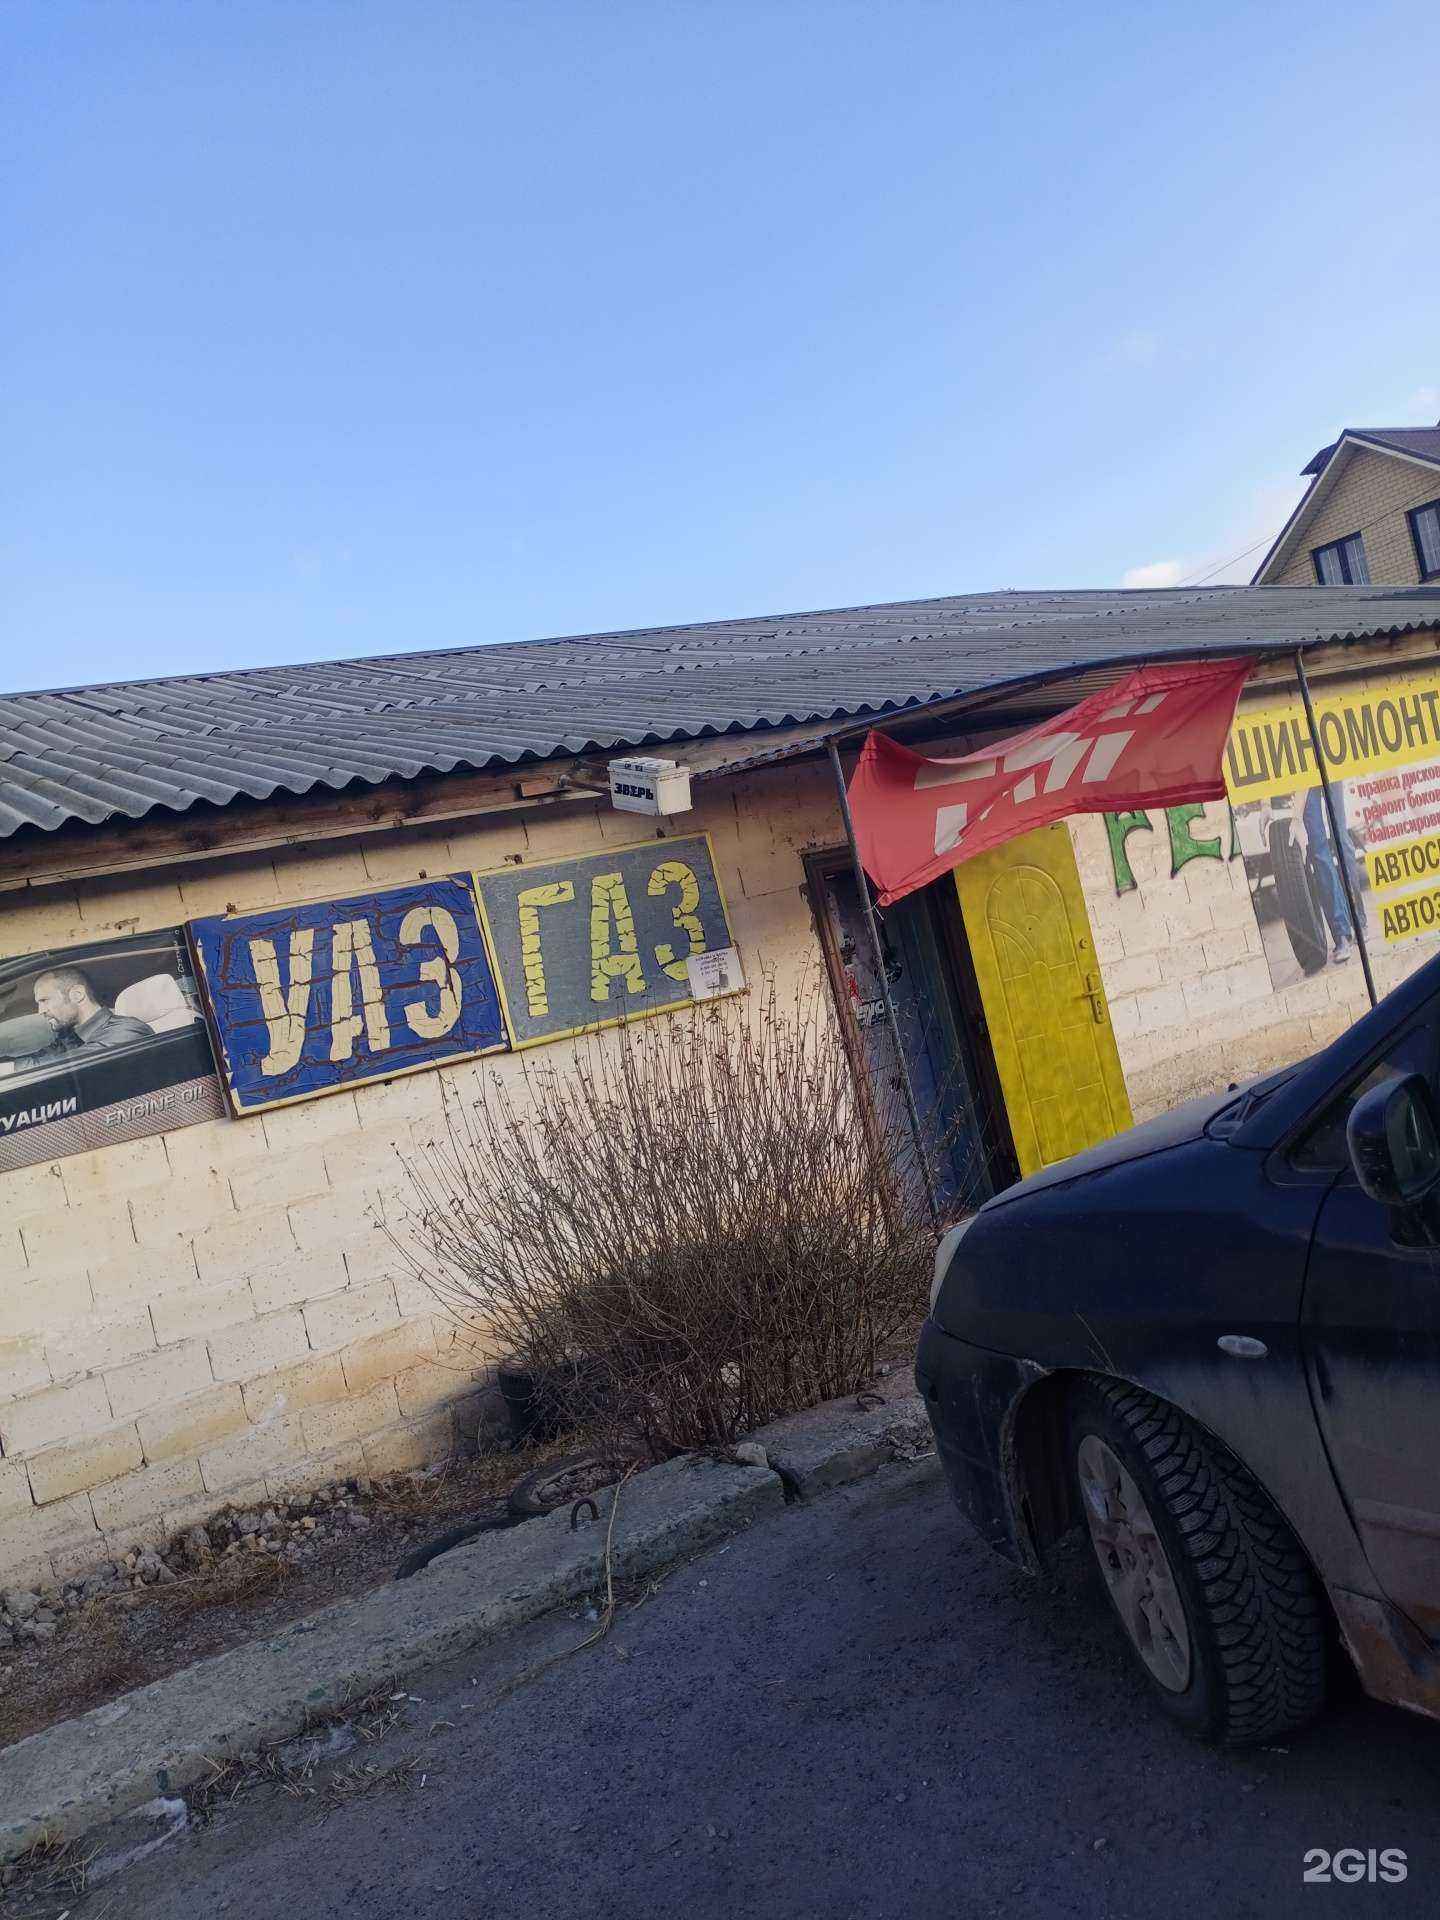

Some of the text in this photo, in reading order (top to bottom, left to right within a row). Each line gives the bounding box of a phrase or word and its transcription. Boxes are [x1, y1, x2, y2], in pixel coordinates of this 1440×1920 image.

[614, 783, 654, 800] ЗВЕРЬ
[1357, 776, 1400, 799] правка
[1363, 798, 1407, 825] ремонт
[1374, 838, 1440, 886] АВТОС
[517, 860, 706, 1017] ГАЗ
[248, 906, 462, 1076] УАЗ
[105, 1086, 209, 1128] ENGINE OIL
